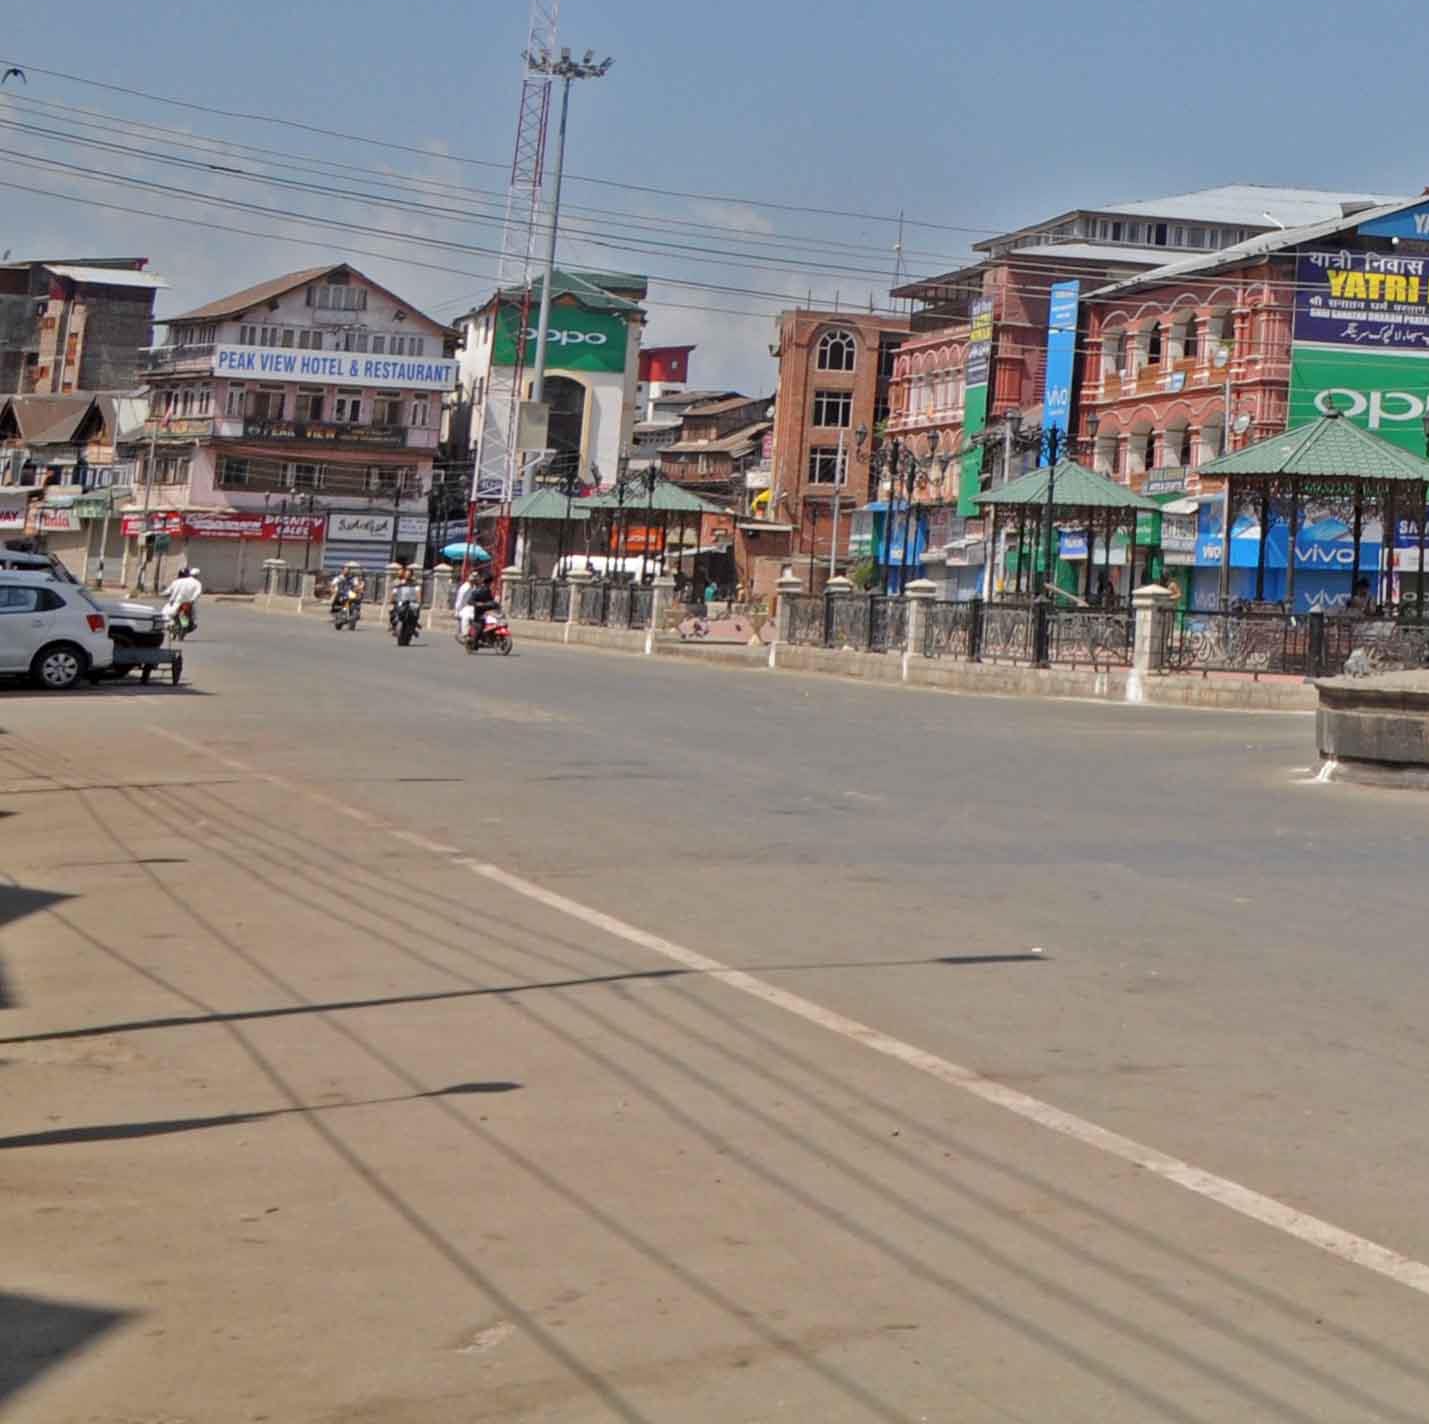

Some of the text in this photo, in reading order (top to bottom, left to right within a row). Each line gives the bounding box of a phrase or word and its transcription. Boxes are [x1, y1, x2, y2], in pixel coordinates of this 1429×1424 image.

[1328, 269, 1419, 304] YATRI
[218, 351, 452, 382] PEAK VIEW HOTEL & RESTAURANT
[1294, 543, 1355, 563] vivo
